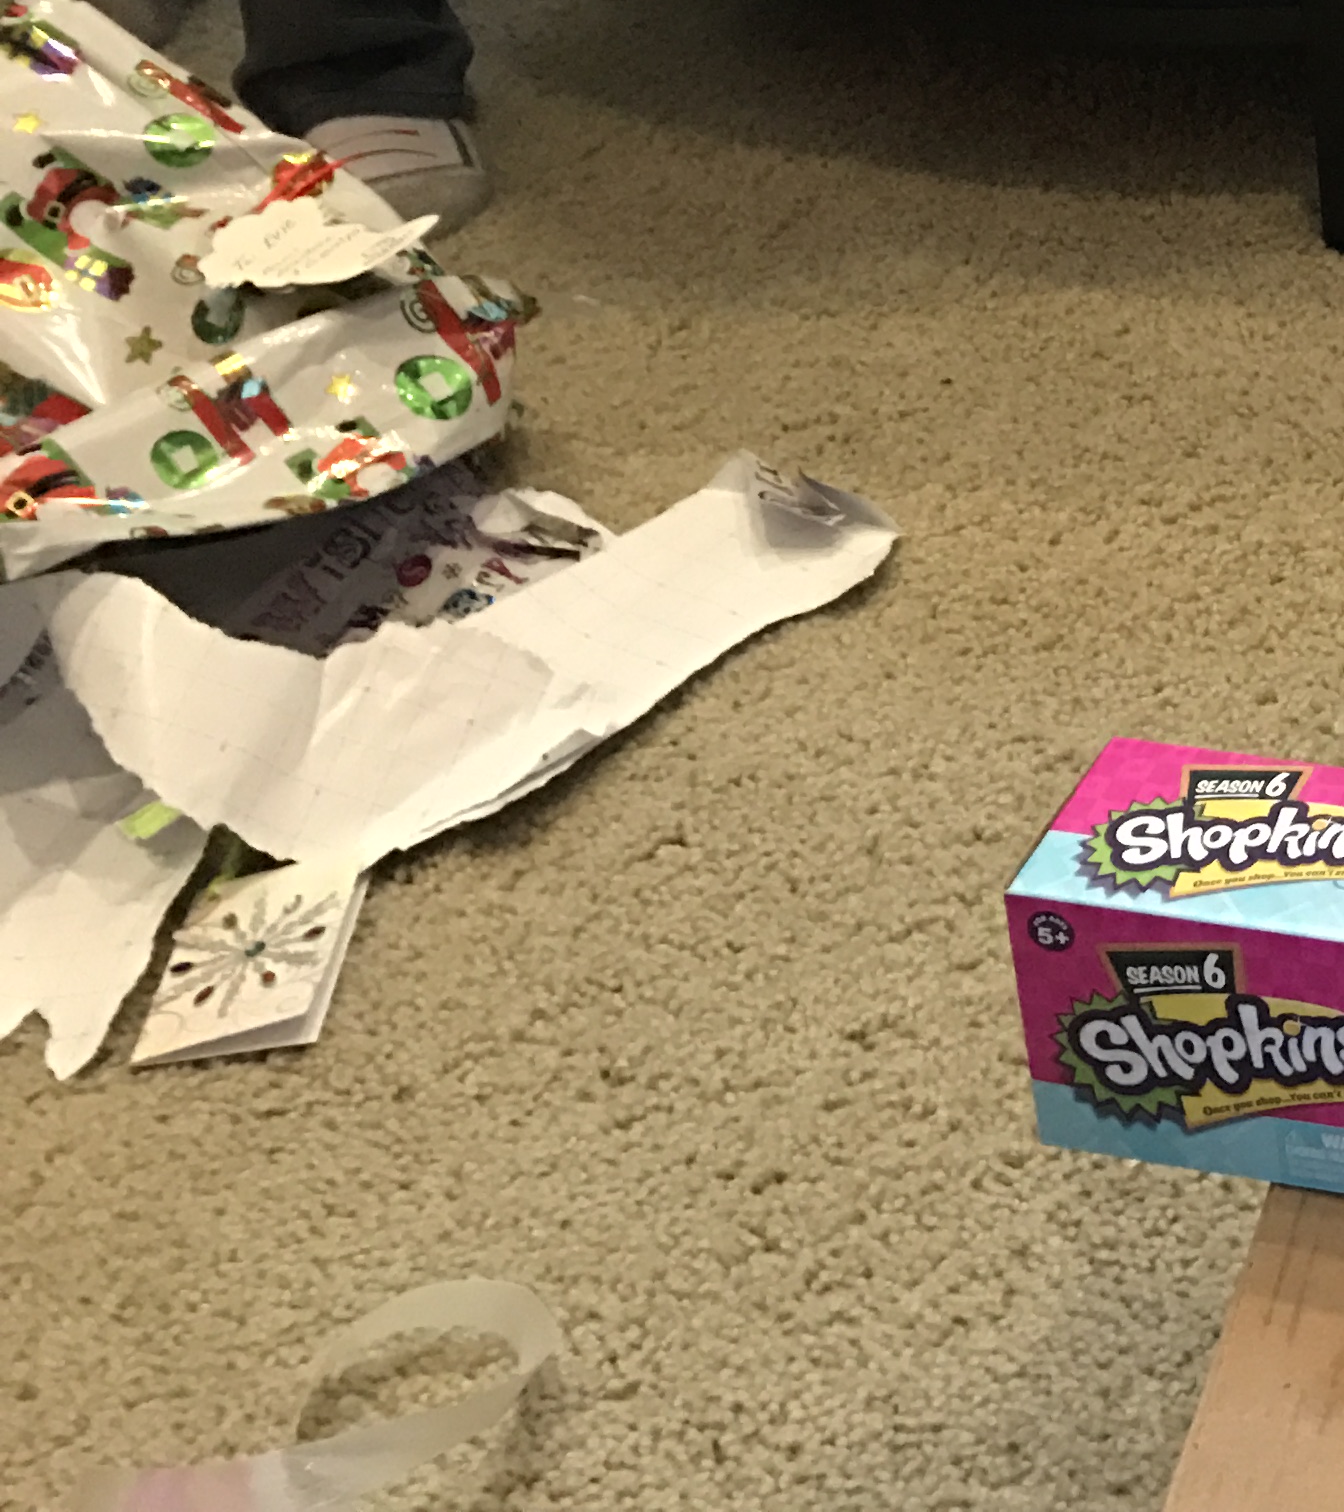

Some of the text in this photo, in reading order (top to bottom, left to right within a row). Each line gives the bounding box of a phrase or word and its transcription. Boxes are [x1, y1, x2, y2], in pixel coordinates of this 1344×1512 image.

[1195, 772, 1292, 797] SEASON 6
[1036, 926, 1070, 946] 5+
[1126, 952, 1226, 989] SEASON 6
